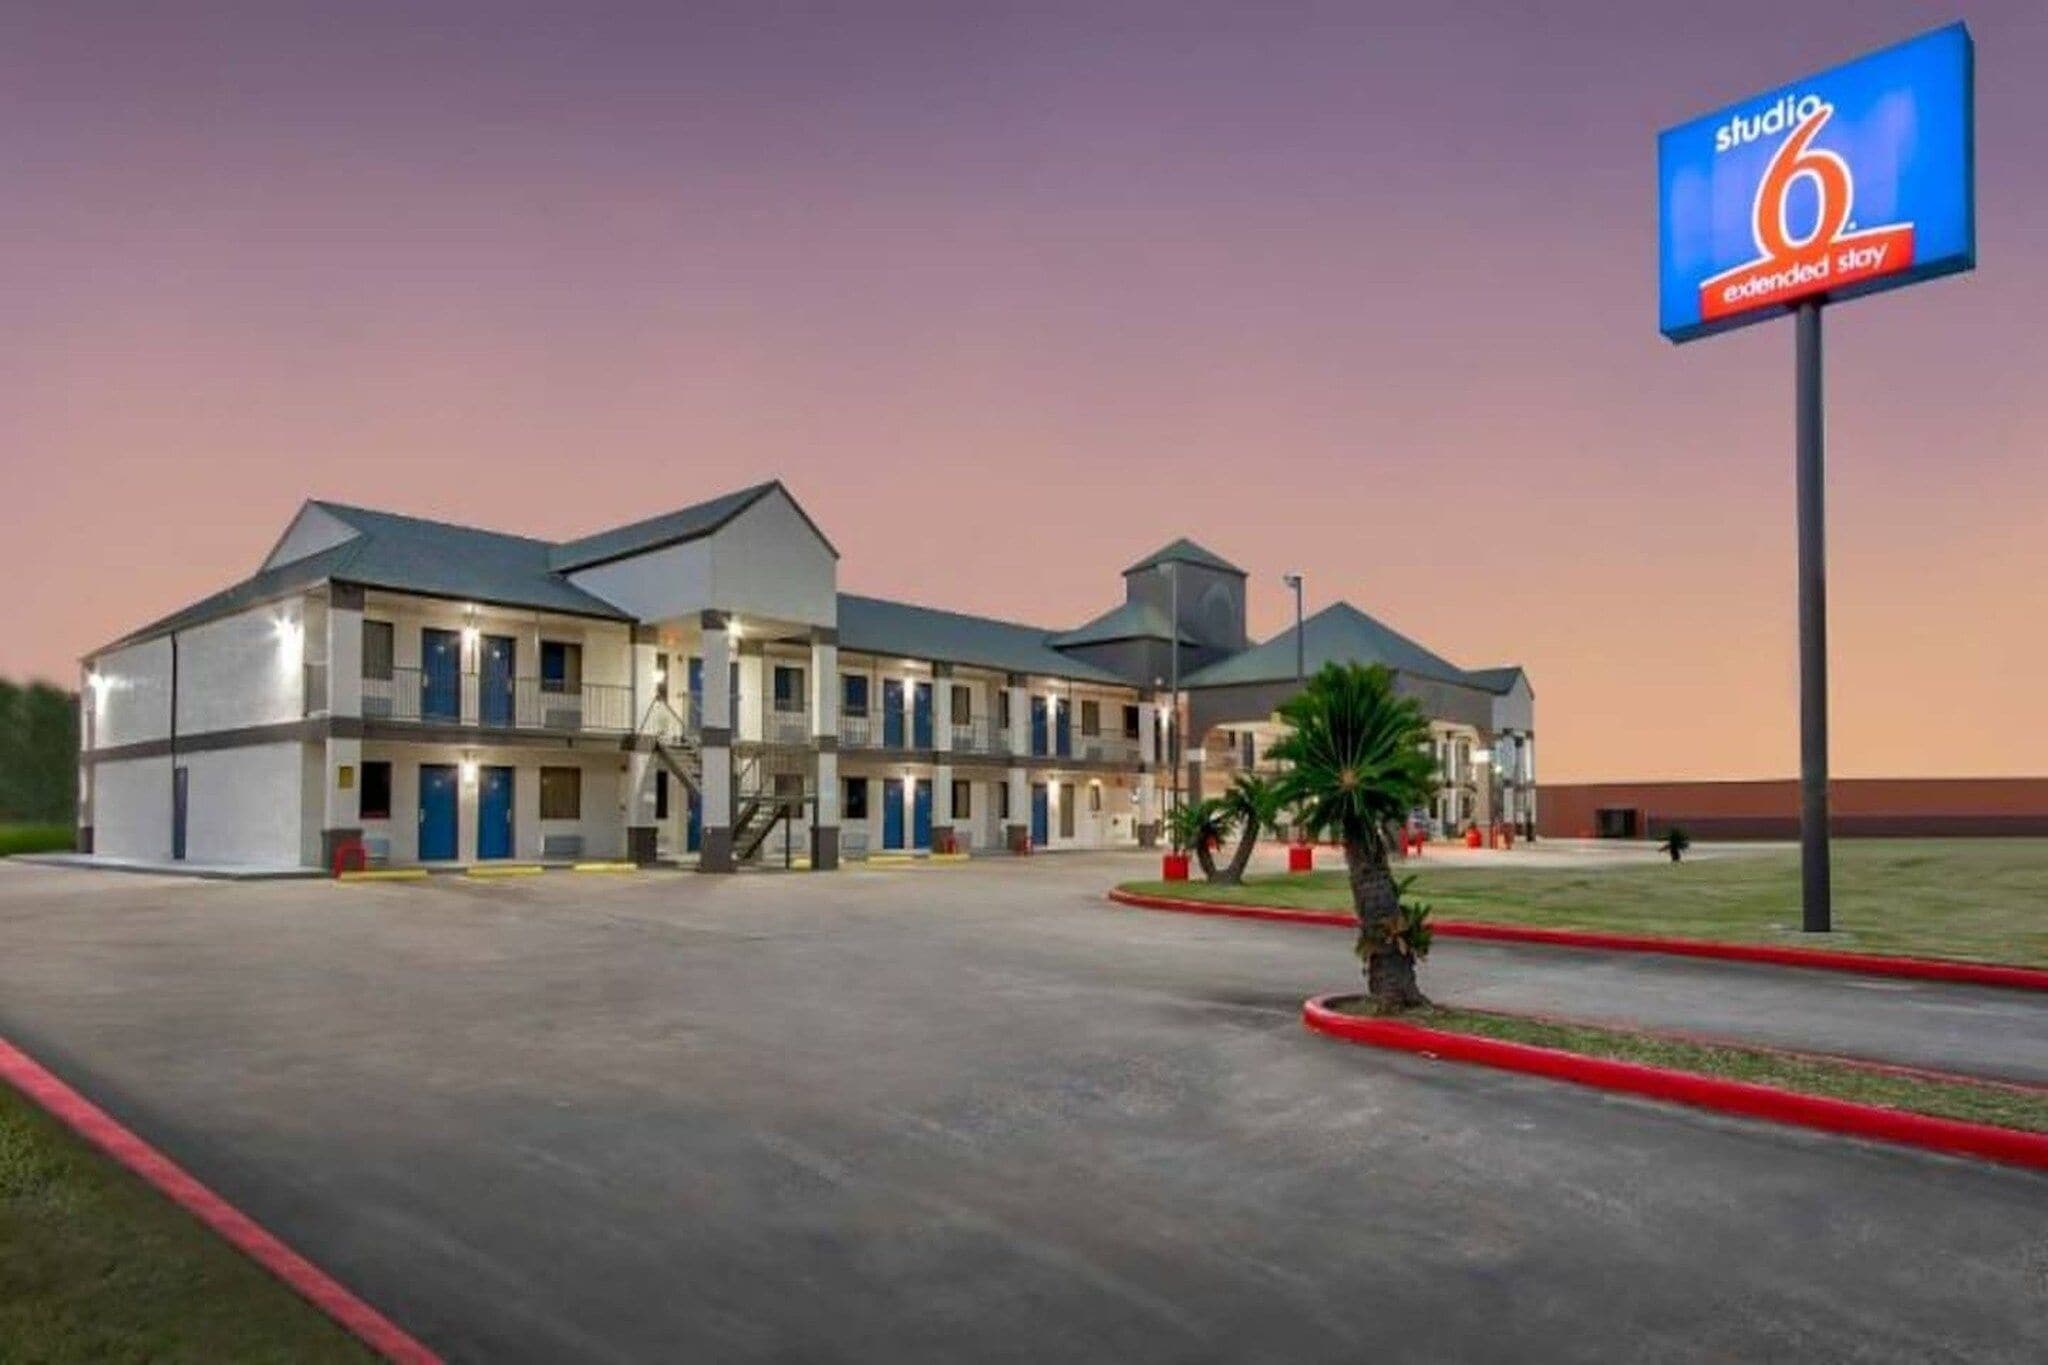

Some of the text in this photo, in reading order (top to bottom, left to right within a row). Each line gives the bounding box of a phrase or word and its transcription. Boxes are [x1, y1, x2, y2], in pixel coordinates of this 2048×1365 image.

[1715, 95, 1822, 151] studio
[1752, 103, 1853, 255] 6
[1723, 243, 1888, 303] extended stay
